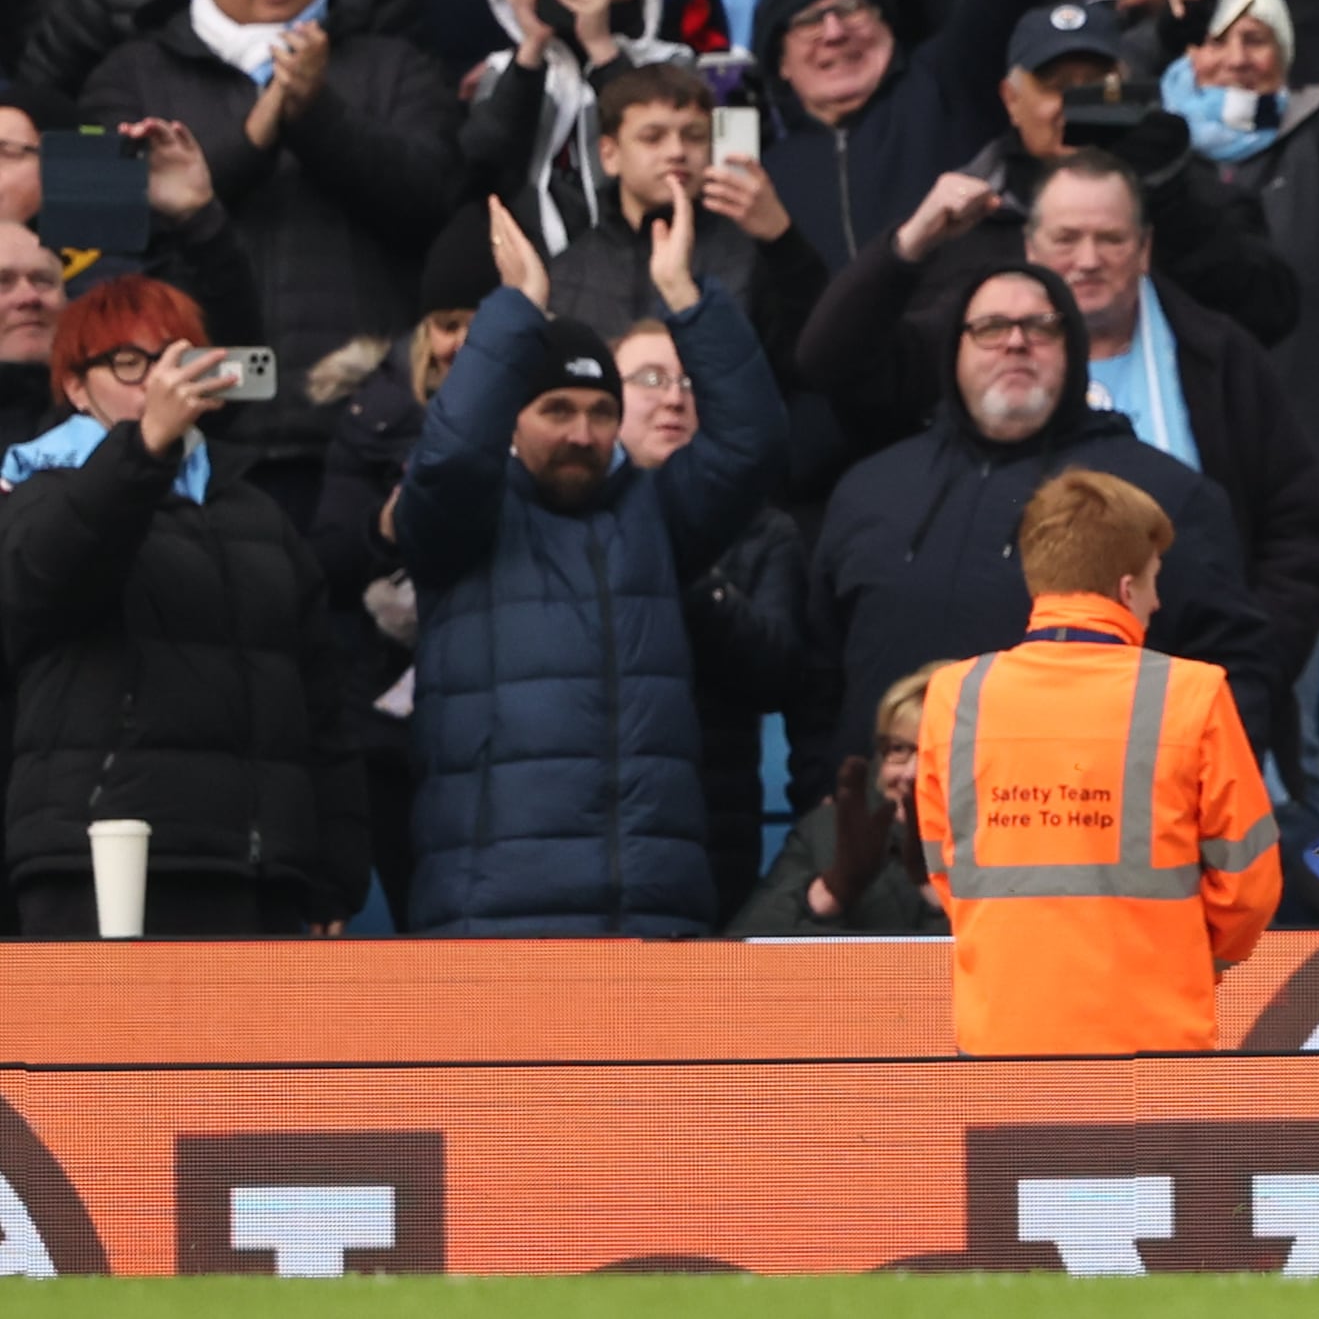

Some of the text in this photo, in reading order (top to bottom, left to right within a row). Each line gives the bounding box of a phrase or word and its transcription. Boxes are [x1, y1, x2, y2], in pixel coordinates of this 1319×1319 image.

[991, 784, 1112, 805] Safety Team
[987, 809, 1114, 830] Here To Help
